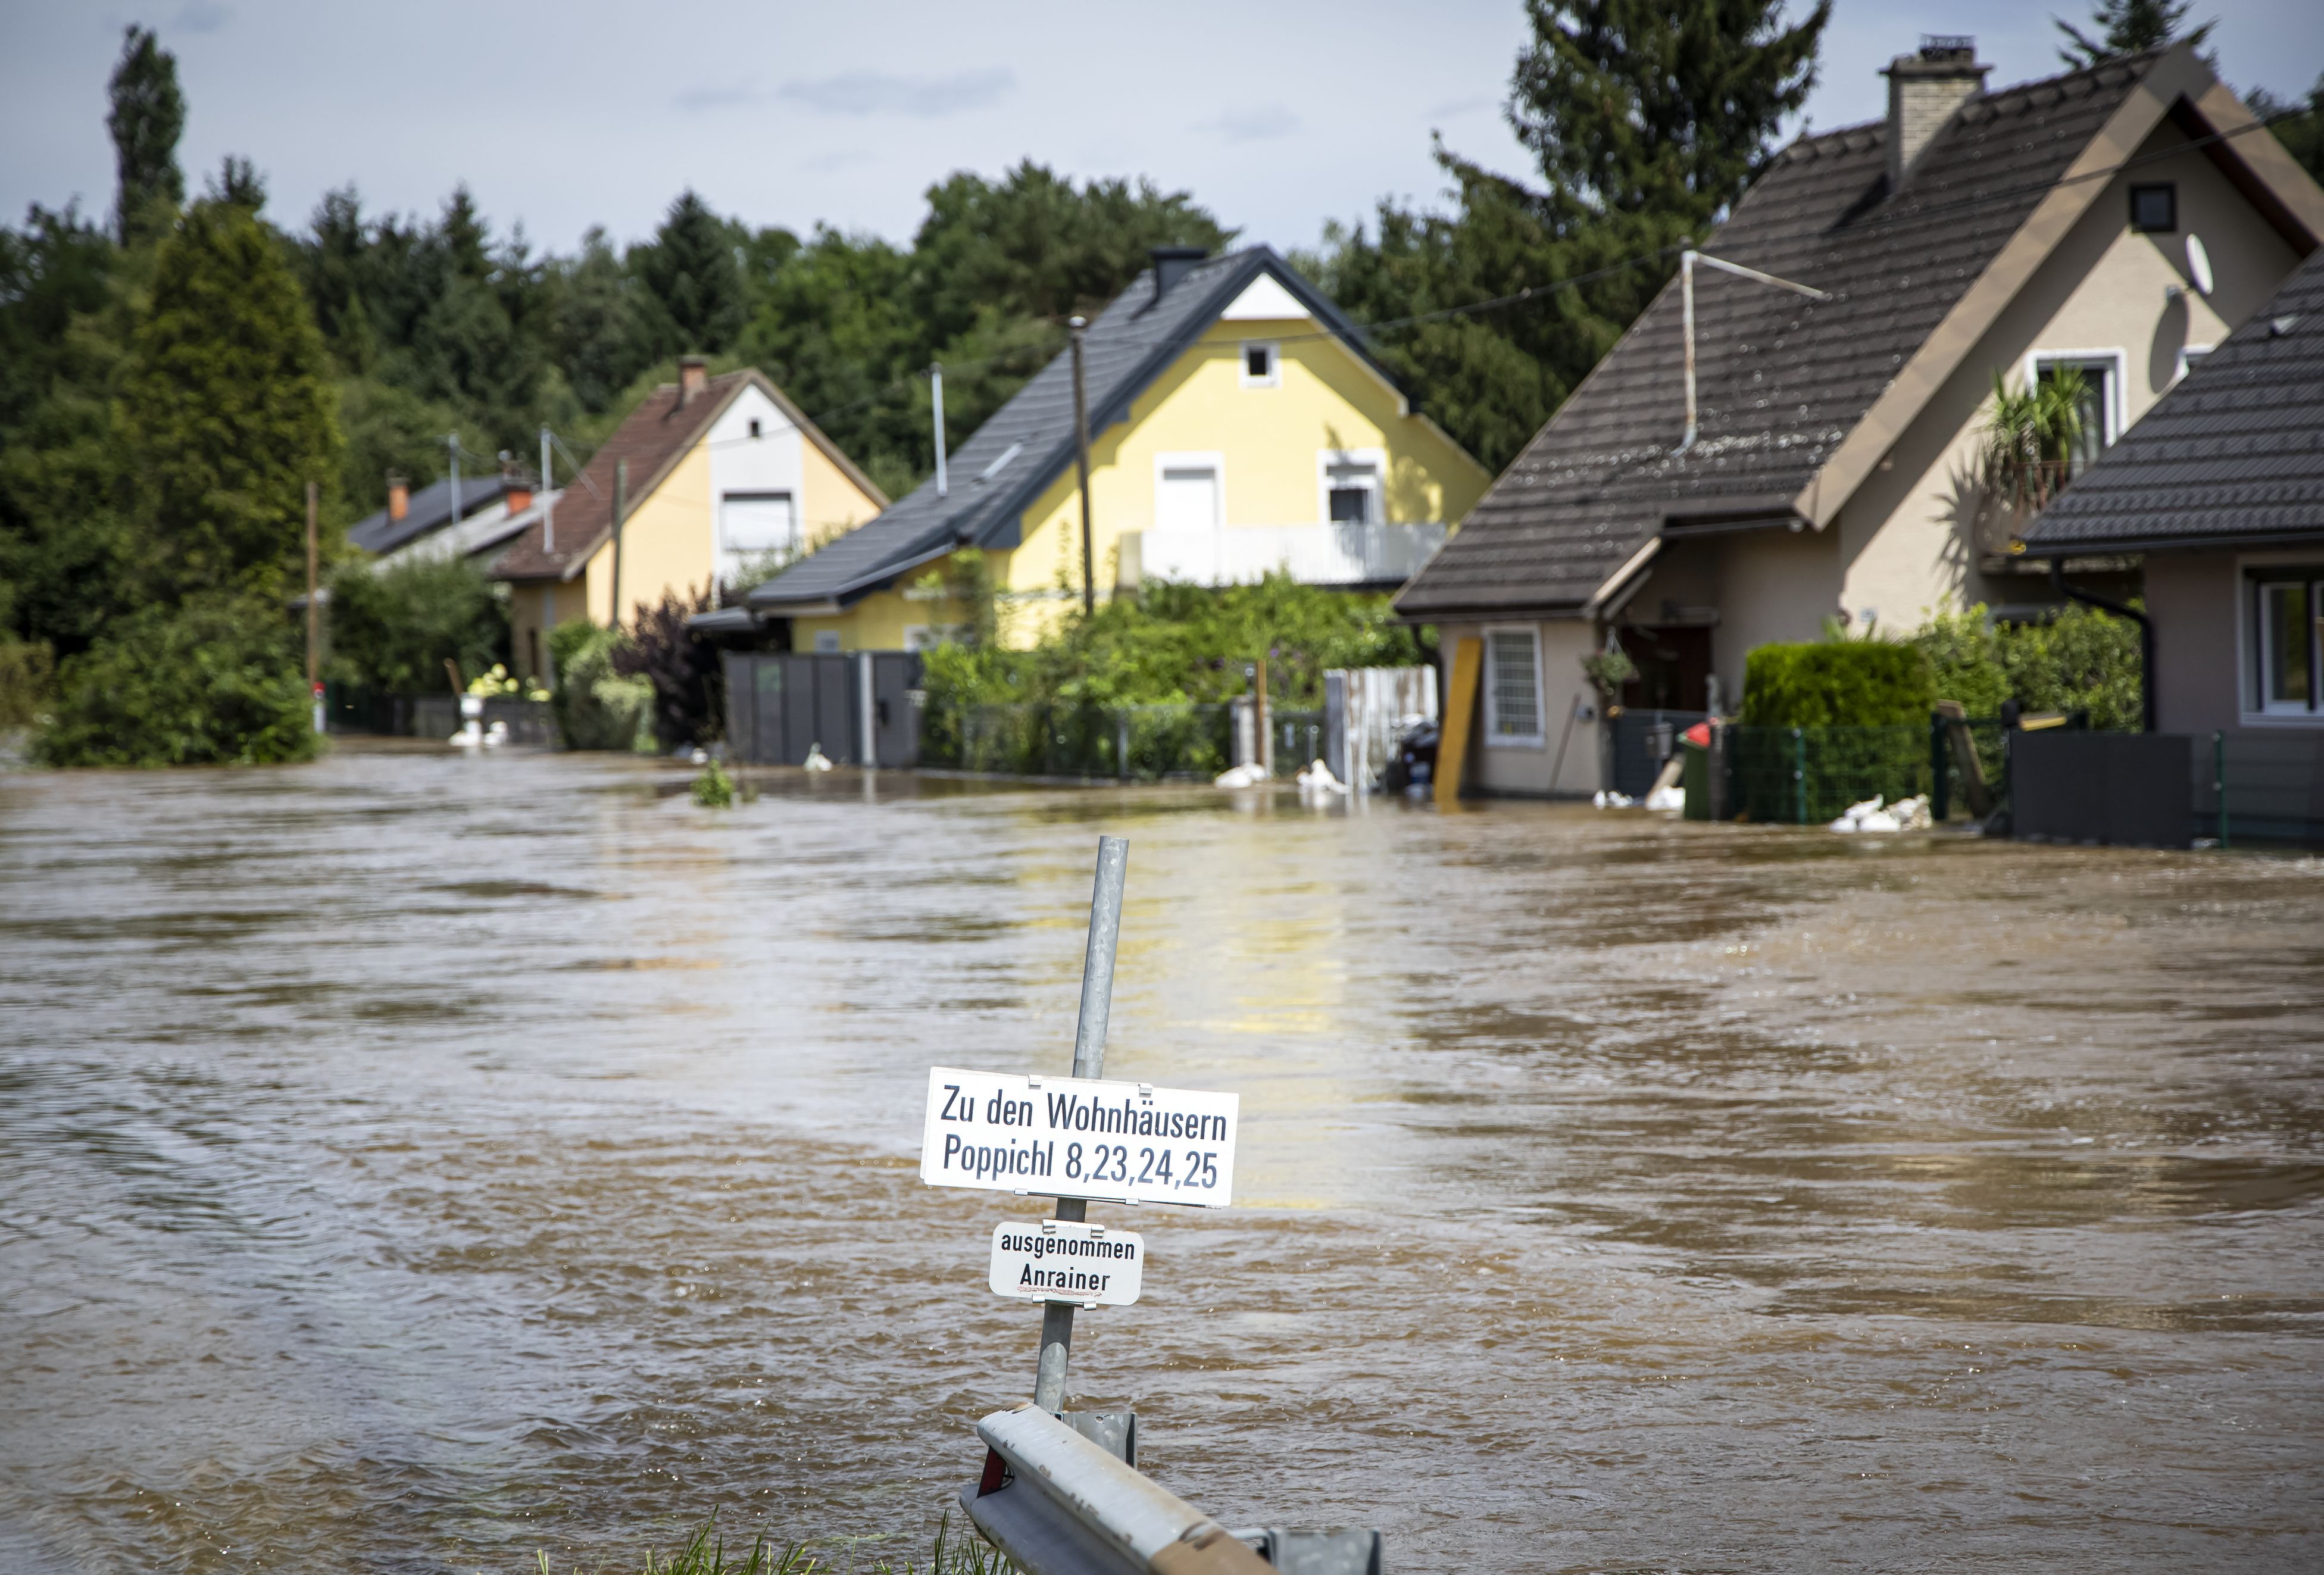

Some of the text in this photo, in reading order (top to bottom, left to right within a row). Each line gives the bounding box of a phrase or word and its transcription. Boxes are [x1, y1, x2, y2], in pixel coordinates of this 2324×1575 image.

[941, 1085, 1226, 1141] Zu den Wohnhäusern
[944, 1133, 1217, 1190] Poppichl 8,23,24,25
[1001, 1234, 1135, 1260] ausgenommen
[1020, 1263, 1111, 1291] Anrainer
